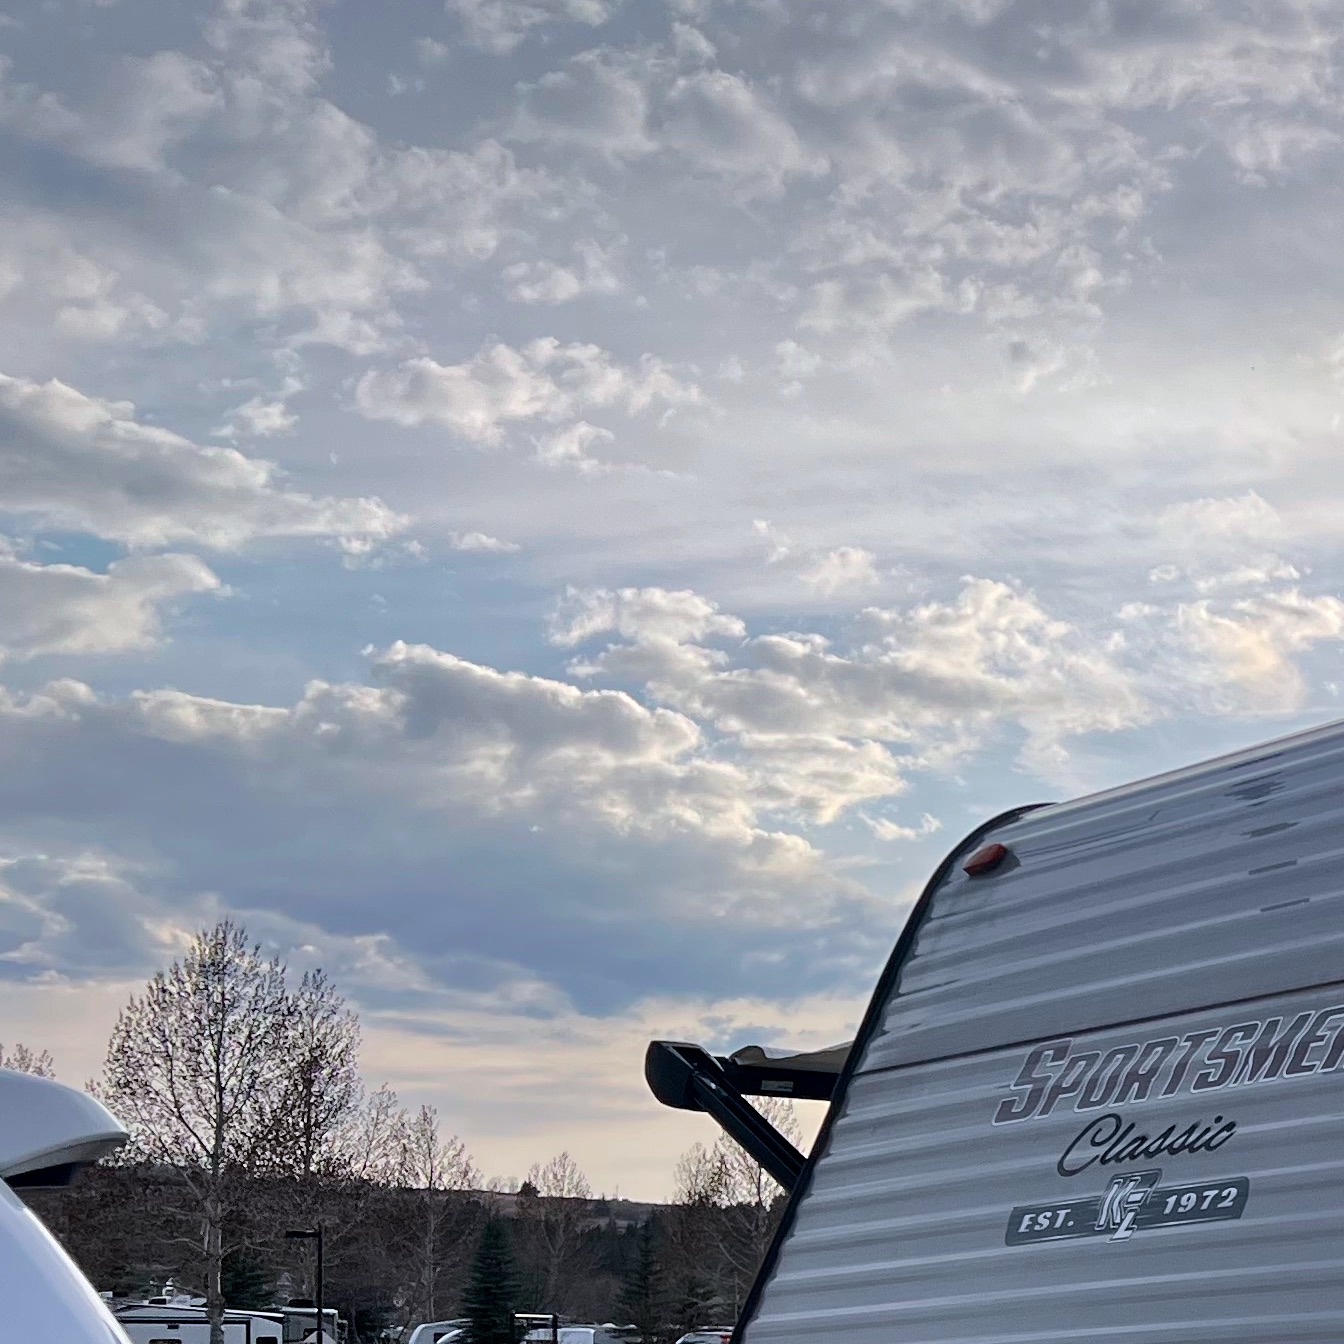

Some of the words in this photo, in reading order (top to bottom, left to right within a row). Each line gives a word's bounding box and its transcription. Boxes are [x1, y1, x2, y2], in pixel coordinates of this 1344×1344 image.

[1057, 1113, 1236, 1177] Classic
[1017, 1209, 1075, 1234] EST.
[1163, 1187, 1238, 1215] 1972
